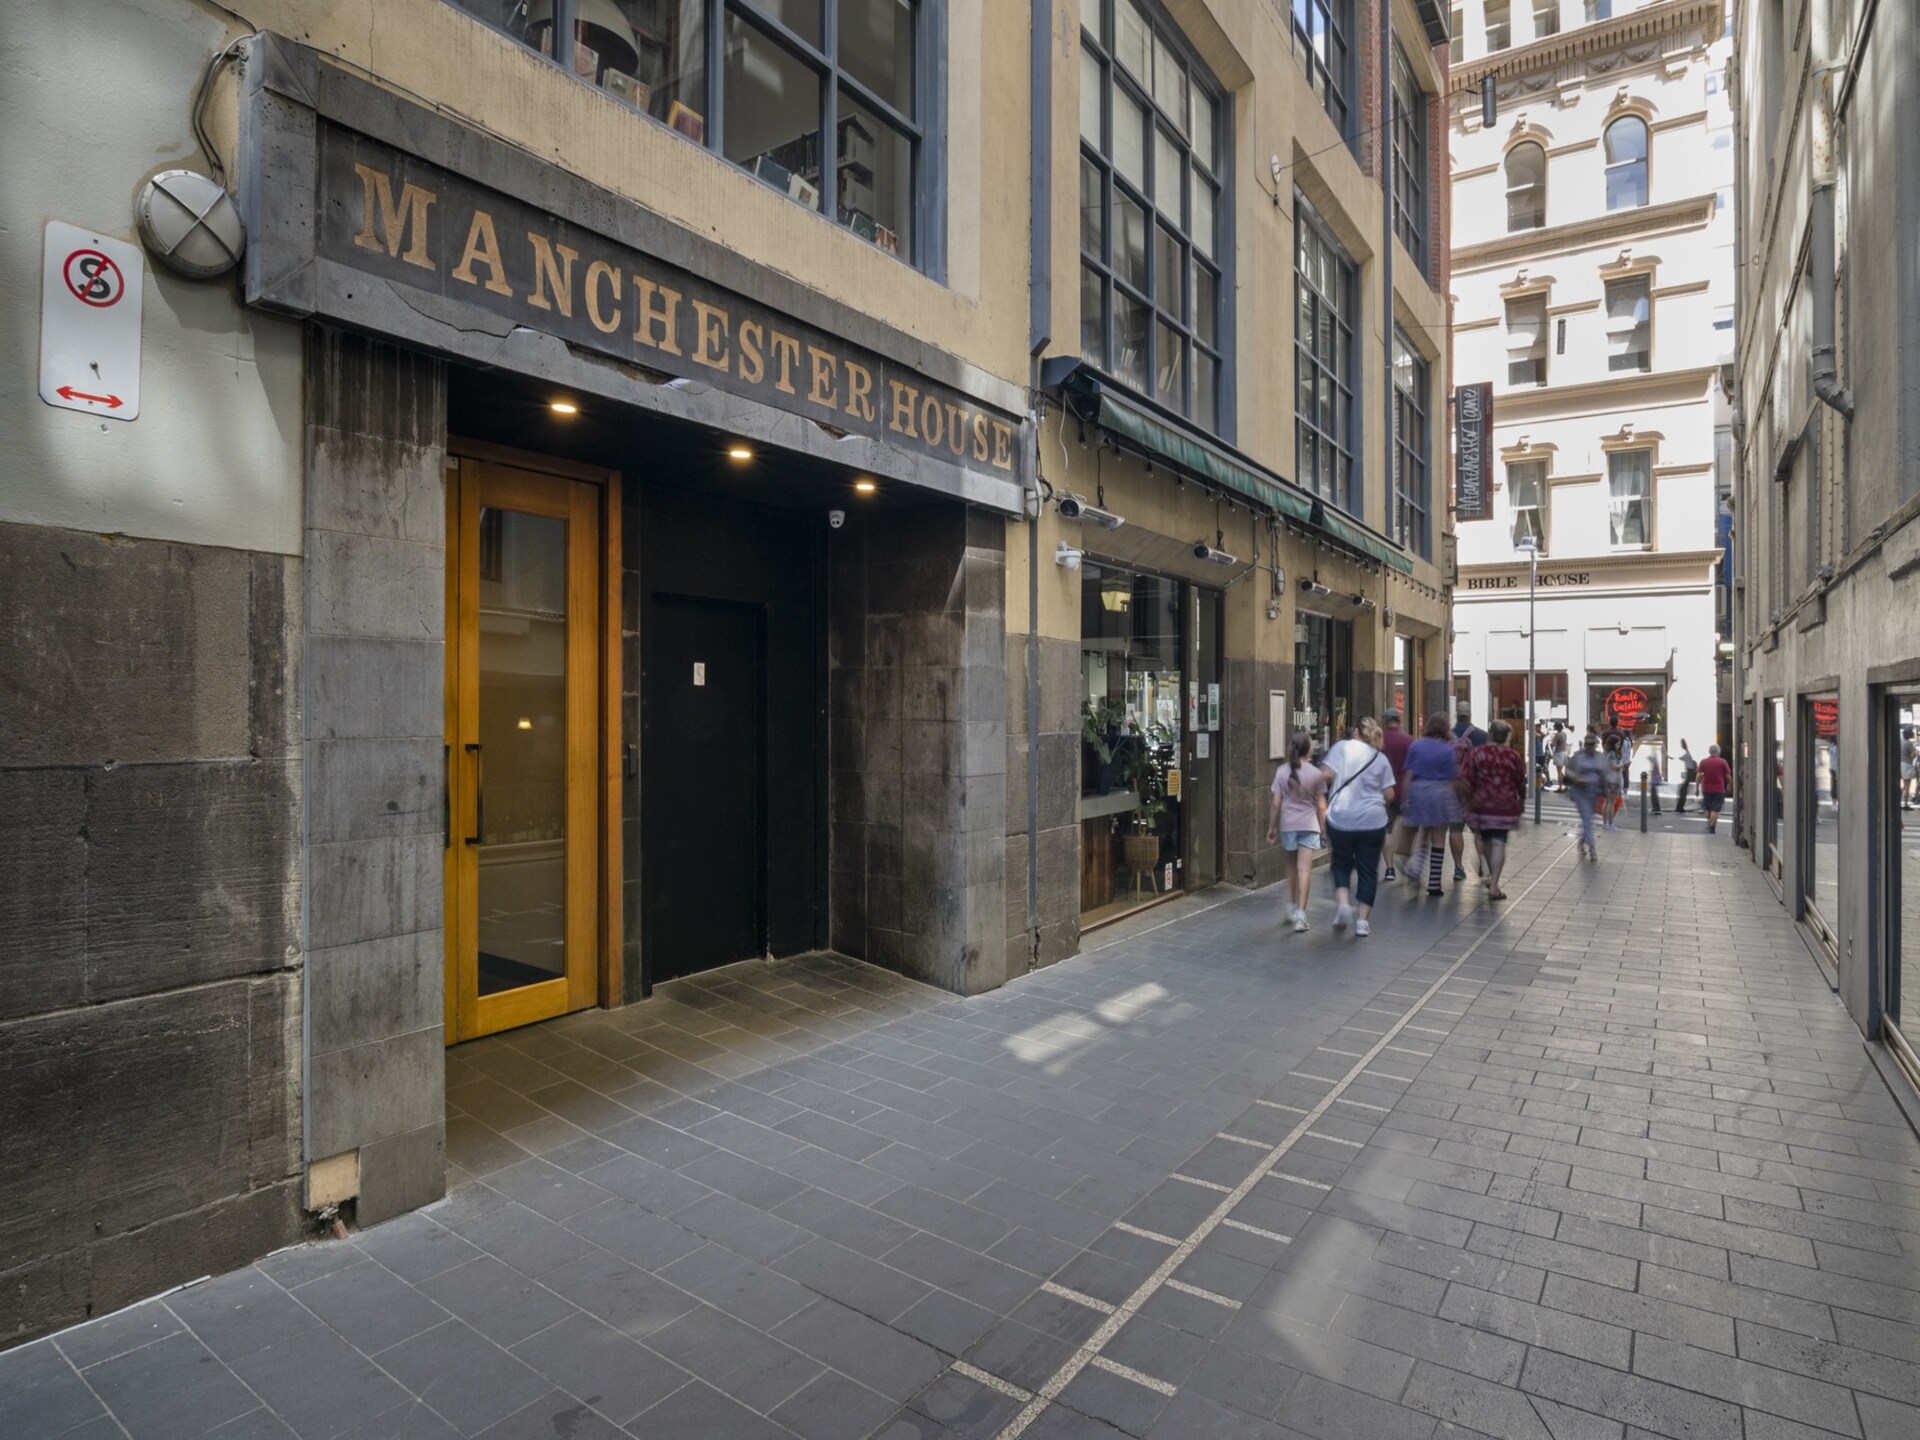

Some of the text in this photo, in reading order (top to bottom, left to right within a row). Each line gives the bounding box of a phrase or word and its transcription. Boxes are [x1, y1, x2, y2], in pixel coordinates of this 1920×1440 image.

[354, 163, 1013, 473] MANCHESTER HOUSE
[1457, 388, 1482, 511] Manchester Lane
[1467, 572, 1590, 590] BIBLE HOUSE
